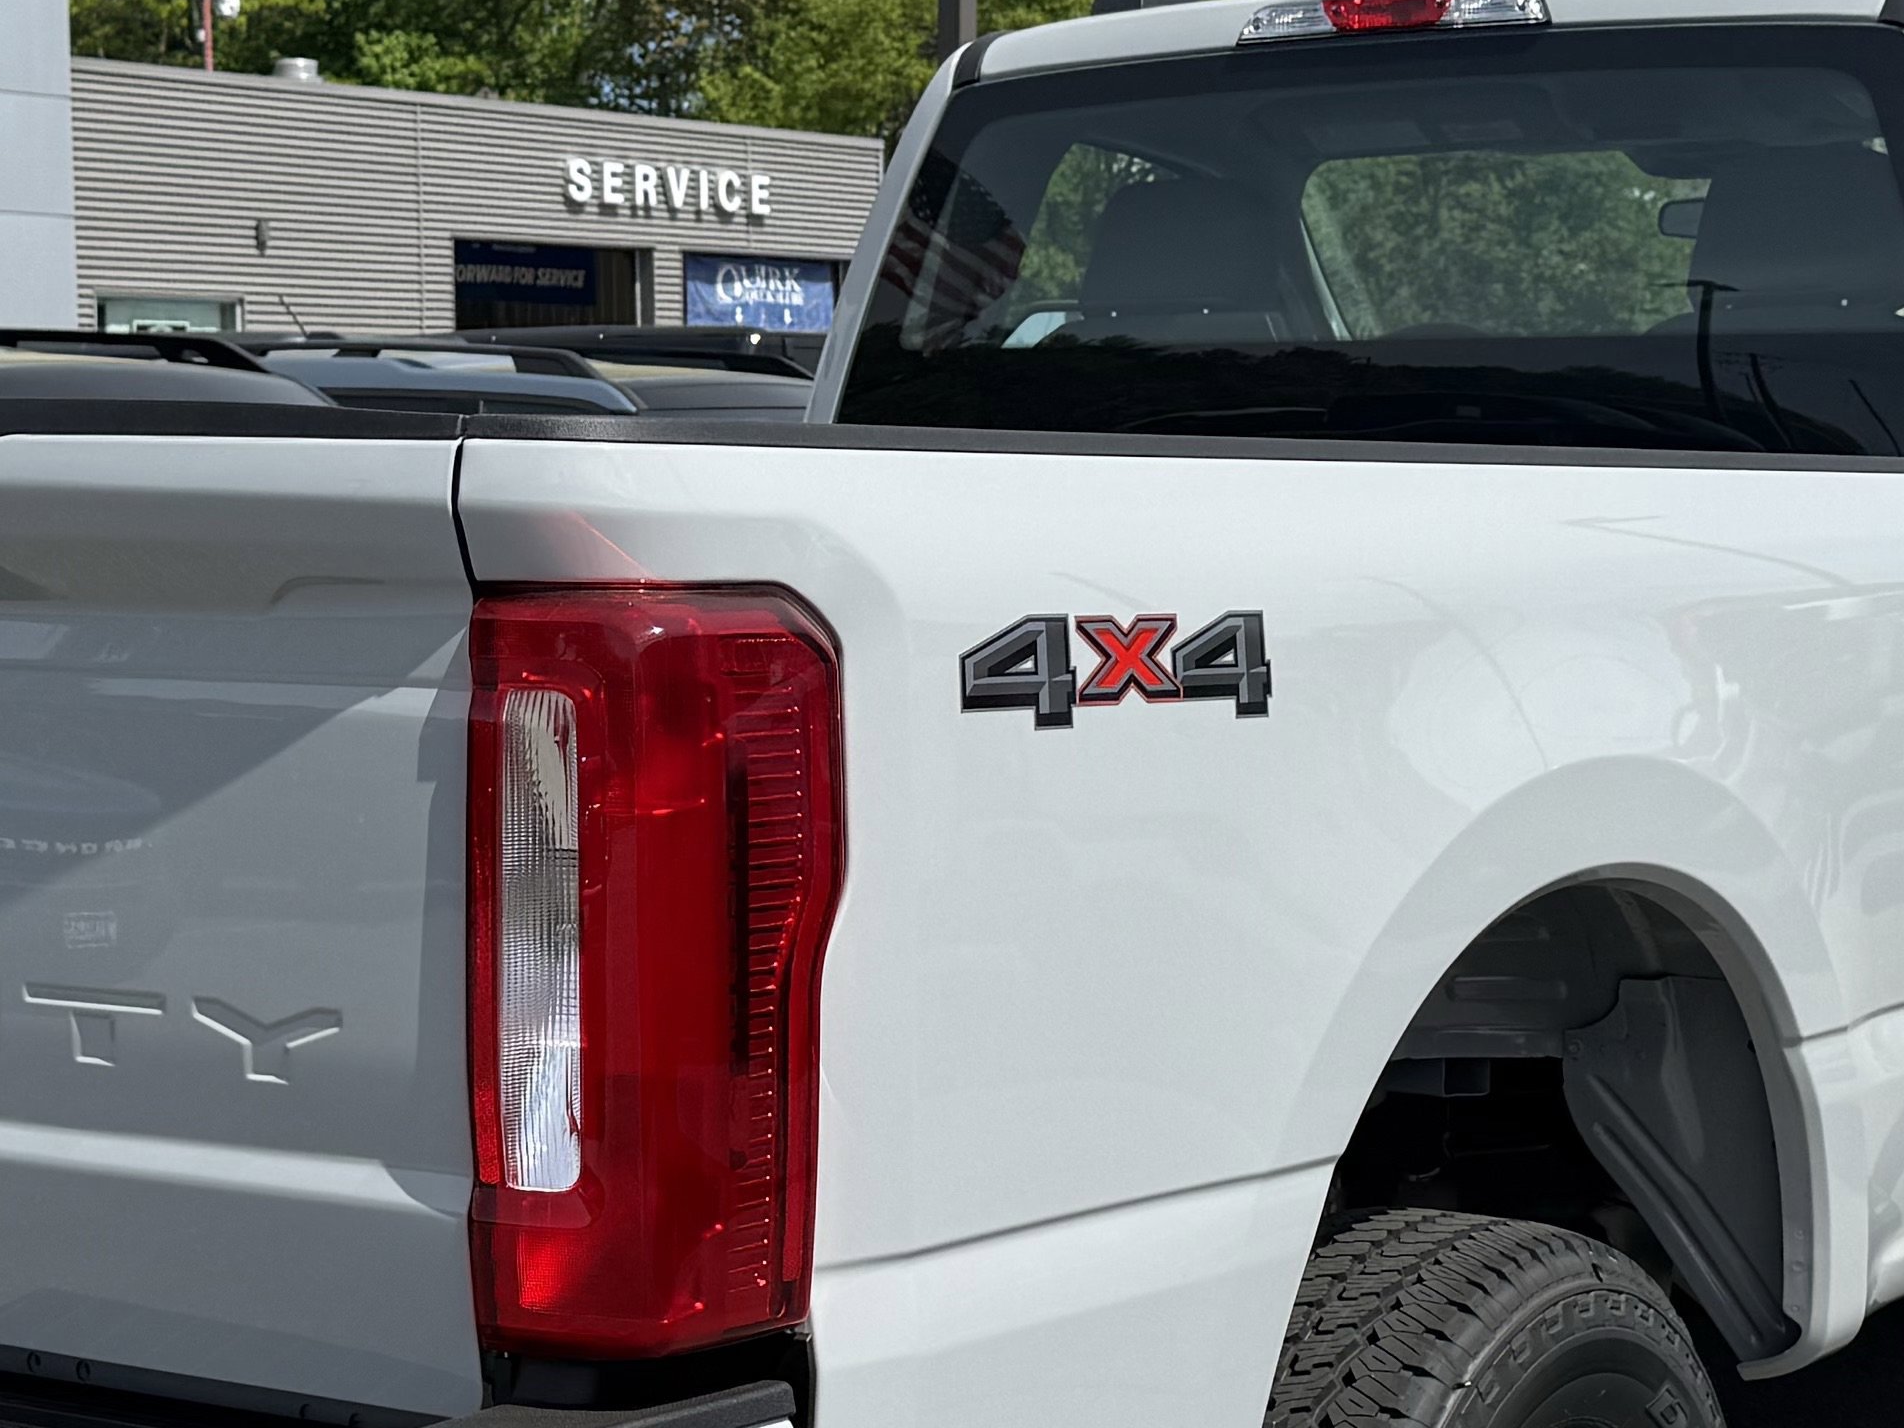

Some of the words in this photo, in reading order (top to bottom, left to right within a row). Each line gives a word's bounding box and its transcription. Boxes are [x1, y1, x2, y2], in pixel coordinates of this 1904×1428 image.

[568, 158, 771, 215] SERVICE
[455, 264, 512, 284] ORWARD
[537, 267, 586, 288] SERVICE
[715, 263, 802, 303] QUIRK
